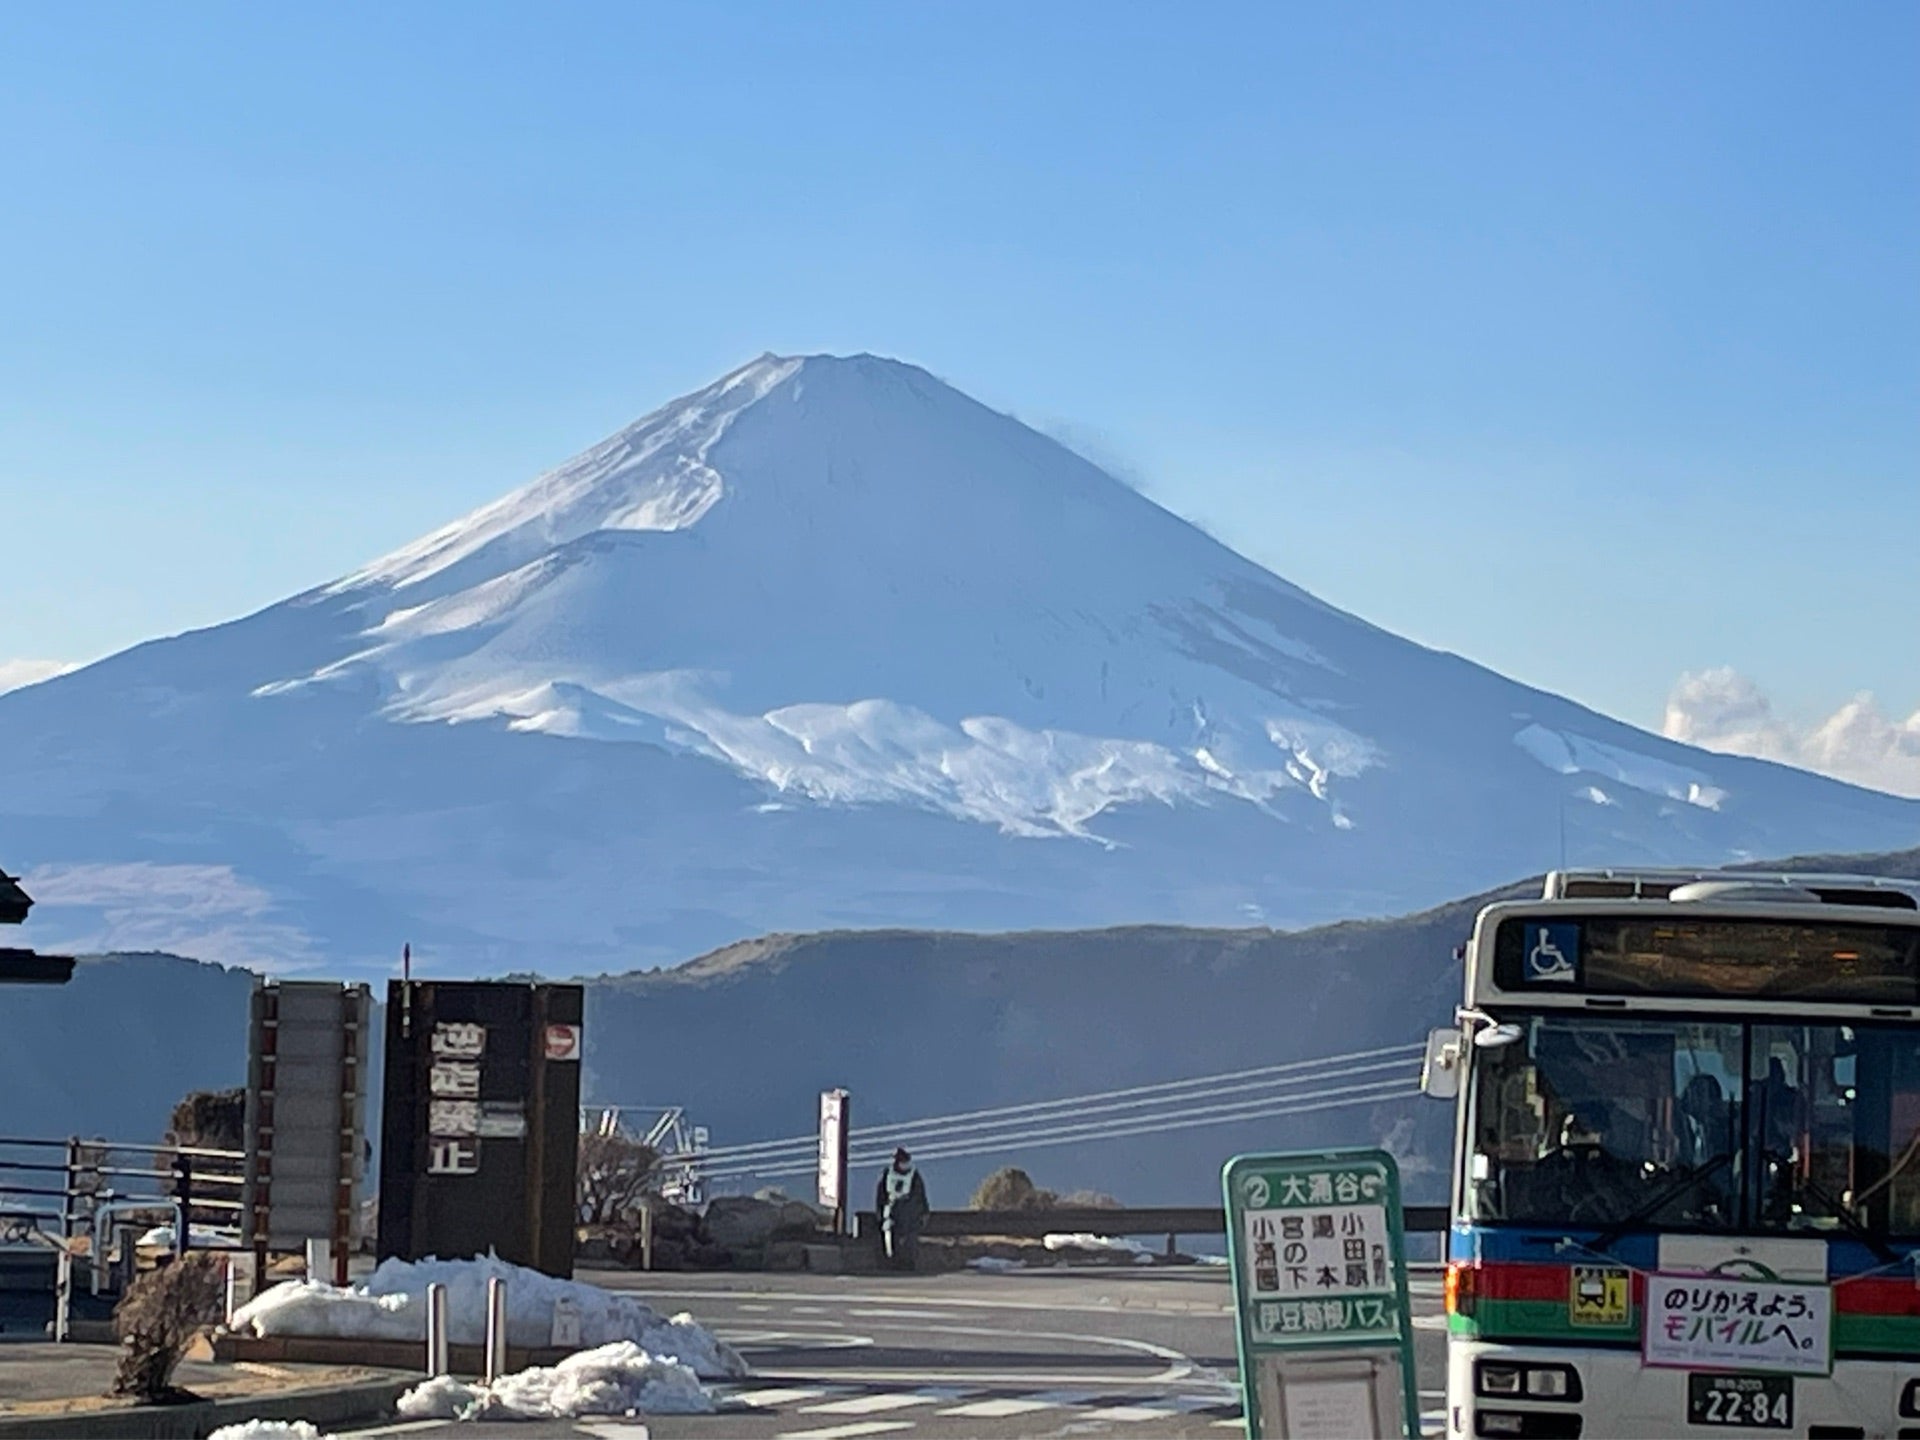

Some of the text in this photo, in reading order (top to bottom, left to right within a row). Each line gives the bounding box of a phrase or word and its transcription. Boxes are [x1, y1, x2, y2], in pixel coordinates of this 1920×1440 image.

[1281, 1173, 1359, 1204] 大涌谷
[1281, 1217, 1308, 1289] 宮の下
[1342, 1212, 1368, 1288] 小田原
[1260, 1299, 1388, 1331] 伊豆箱根バス
[1664, 1316, 1814, 1349] モバイルへ。
